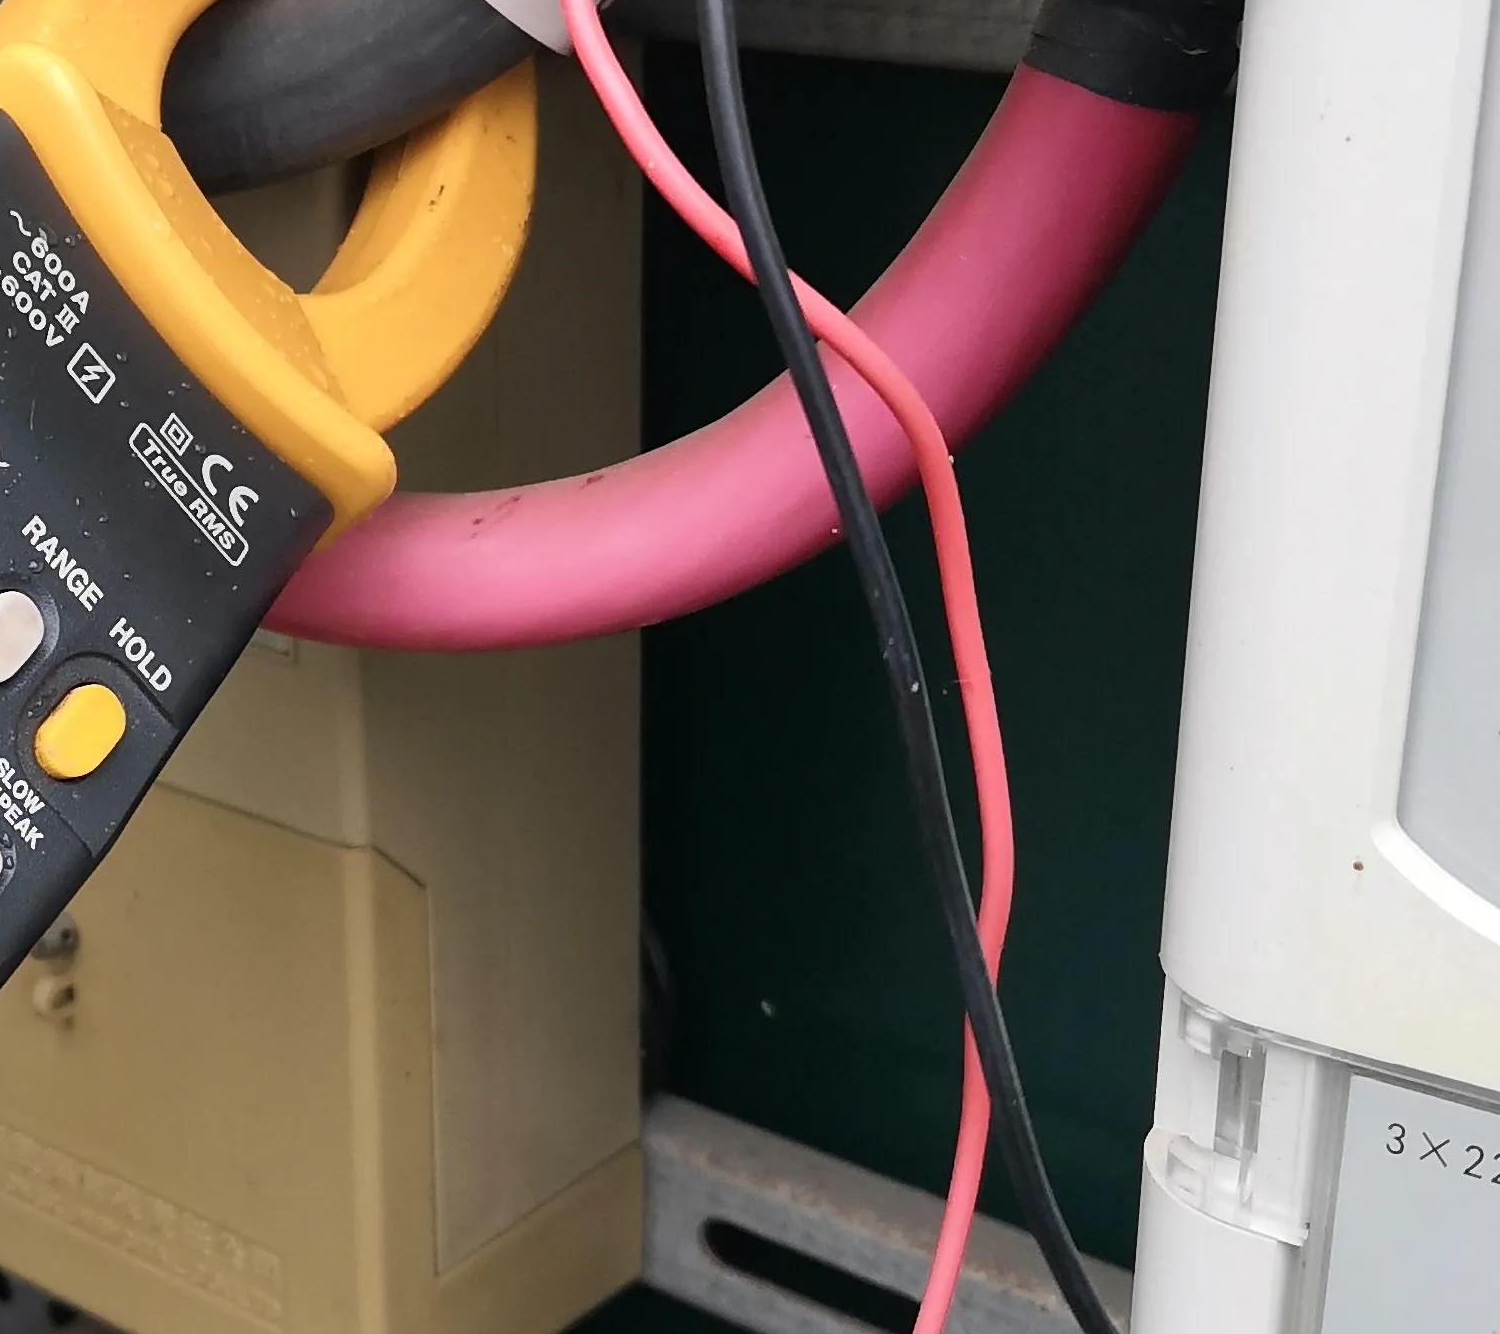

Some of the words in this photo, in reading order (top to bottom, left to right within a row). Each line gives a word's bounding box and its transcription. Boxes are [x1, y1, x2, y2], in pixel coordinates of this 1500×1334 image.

[12, 250, 57, 302] CAT
[142, 438, 189, 498] True
[189, 497, 236, 550] RMS
[21, 515, 104, 612] RANGE
[108, 617, 173, 692] HOLD
